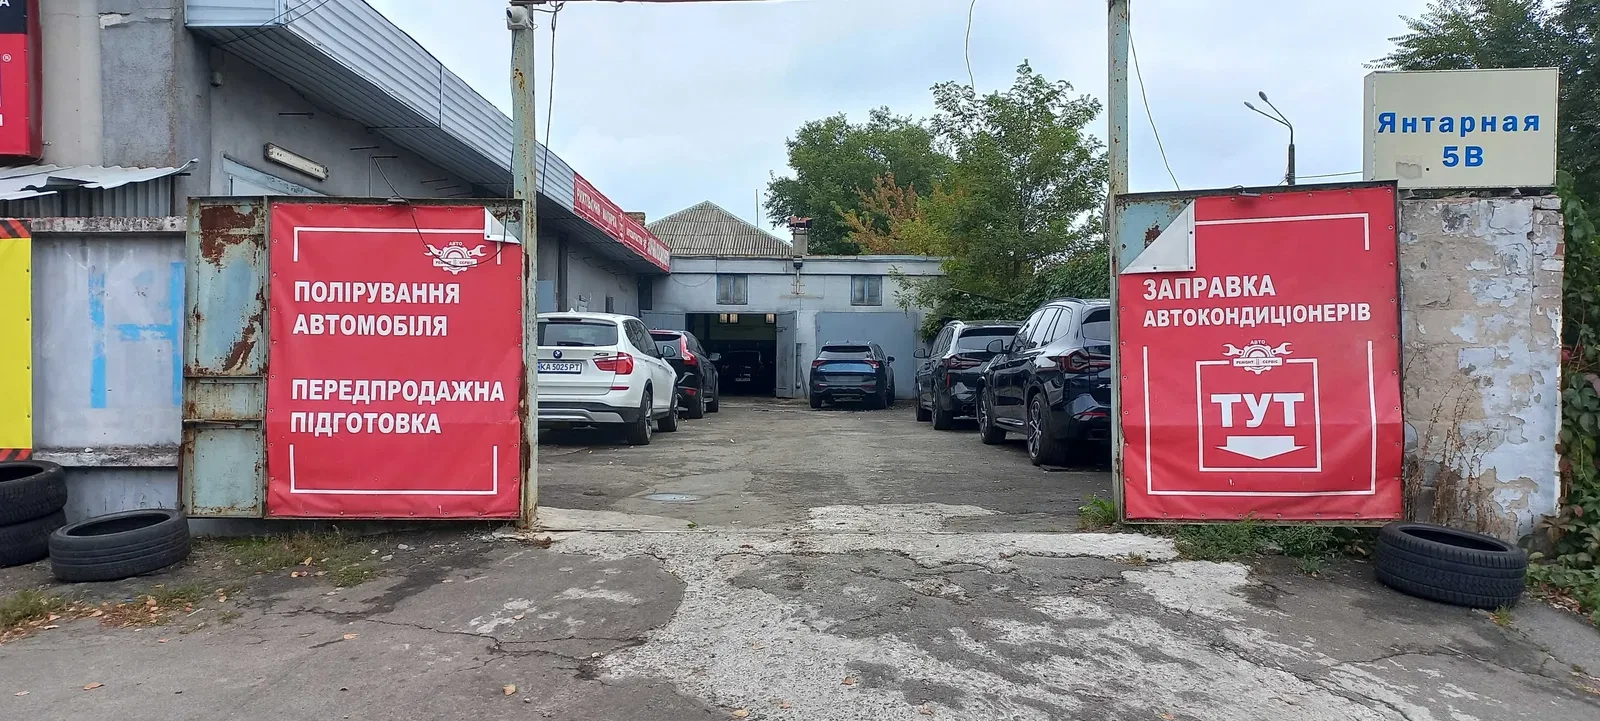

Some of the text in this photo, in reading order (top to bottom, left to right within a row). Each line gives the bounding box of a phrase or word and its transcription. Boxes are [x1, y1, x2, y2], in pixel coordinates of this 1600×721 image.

[1377, 112, 1541, 138] Янтарная
[1442, 145, 1484, 168] 5В
[293, 280, 460, 304] ПОЛІРУВАННЯ
[1142, 273, 1276, 300] ЗАПРАВКА
[292, 313, 448, 337] АВТОМОБІЛЯ
[1143, 302, 1371, 328] АВТОКОНДИЦІОНЕРІВ
[540, 363, 580, 371] KA 5025 PT
[291, 378, 505, 405] ПЕРЕДПРОДАЖНА
[1210, 392, 1305, 428] ТУТ
[290, 411, 442, 437] ПІДГОТОВКА
